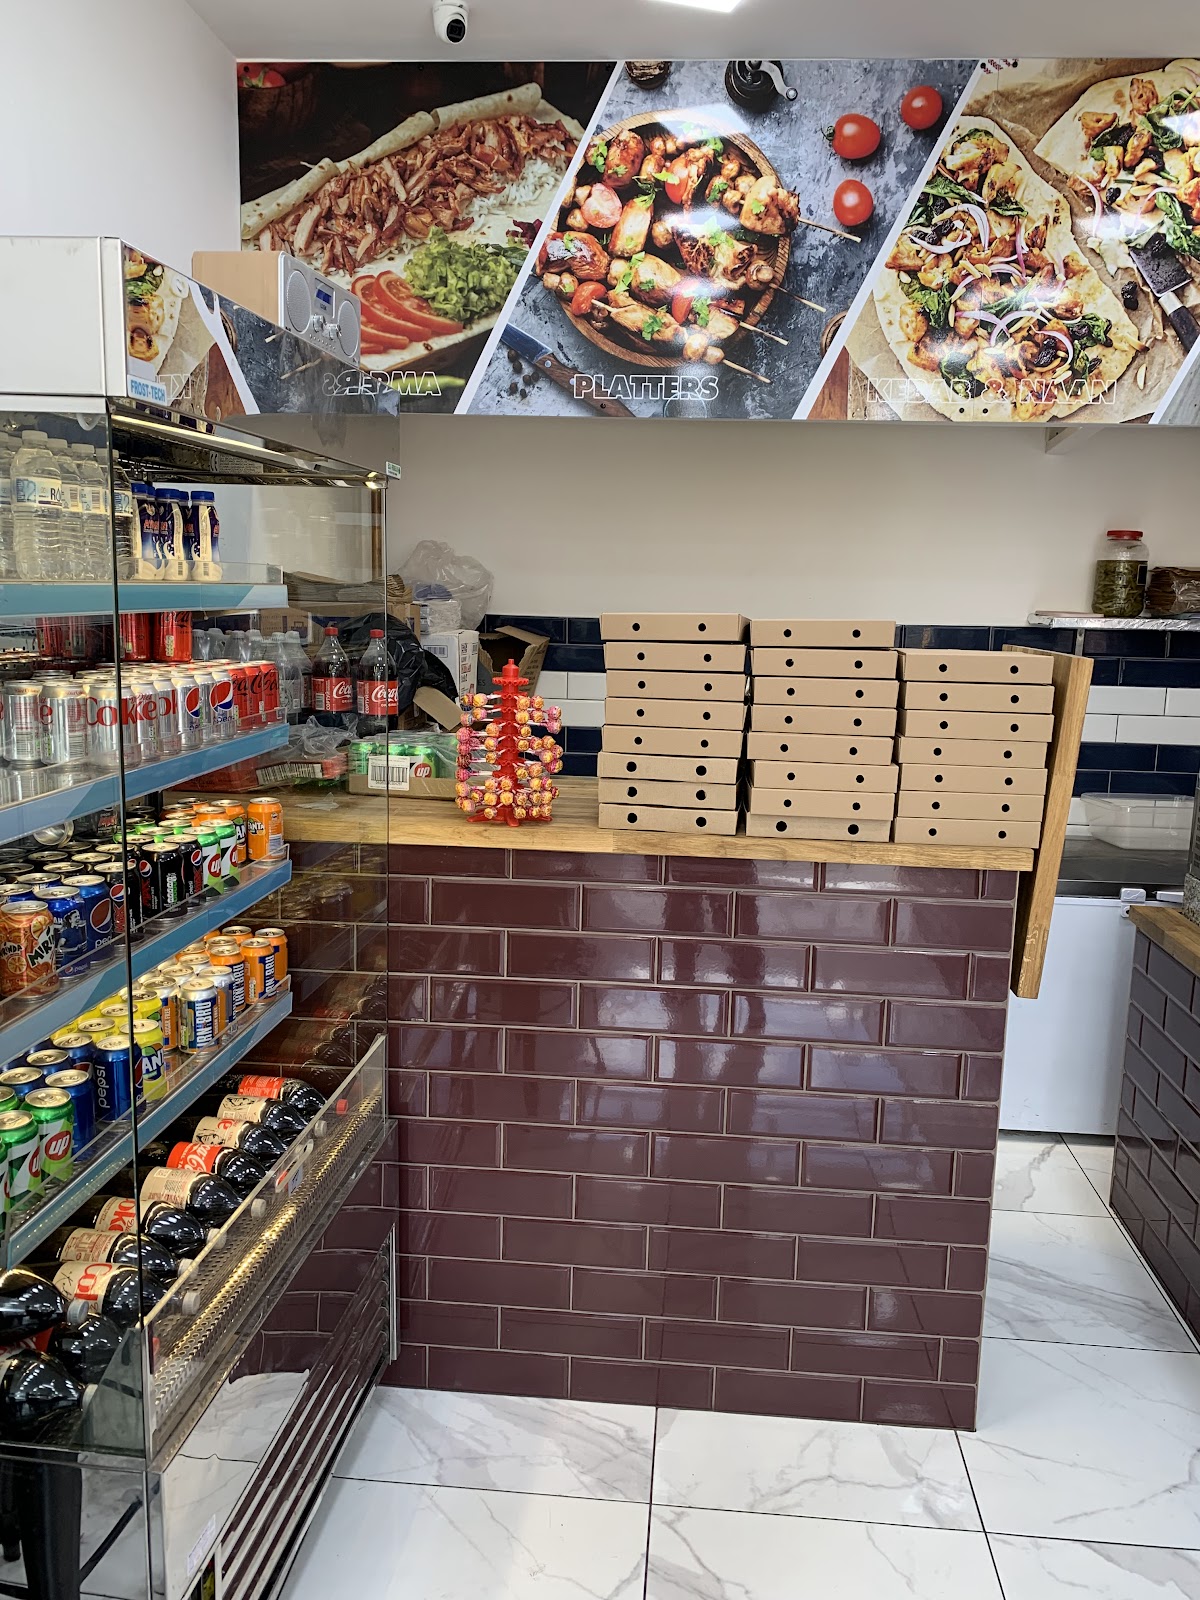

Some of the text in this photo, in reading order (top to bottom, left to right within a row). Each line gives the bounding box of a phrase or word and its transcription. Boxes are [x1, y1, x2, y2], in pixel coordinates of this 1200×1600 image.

[130, 379, 166, 402] FROST-TECH
[573, 374, 719, 400] PLATTERS
[867, 378, 1117, 405] KEBAB & NAAN
[95, 1064, 110, 1109] pepsi
[48, 1134, 70, 1156] up
